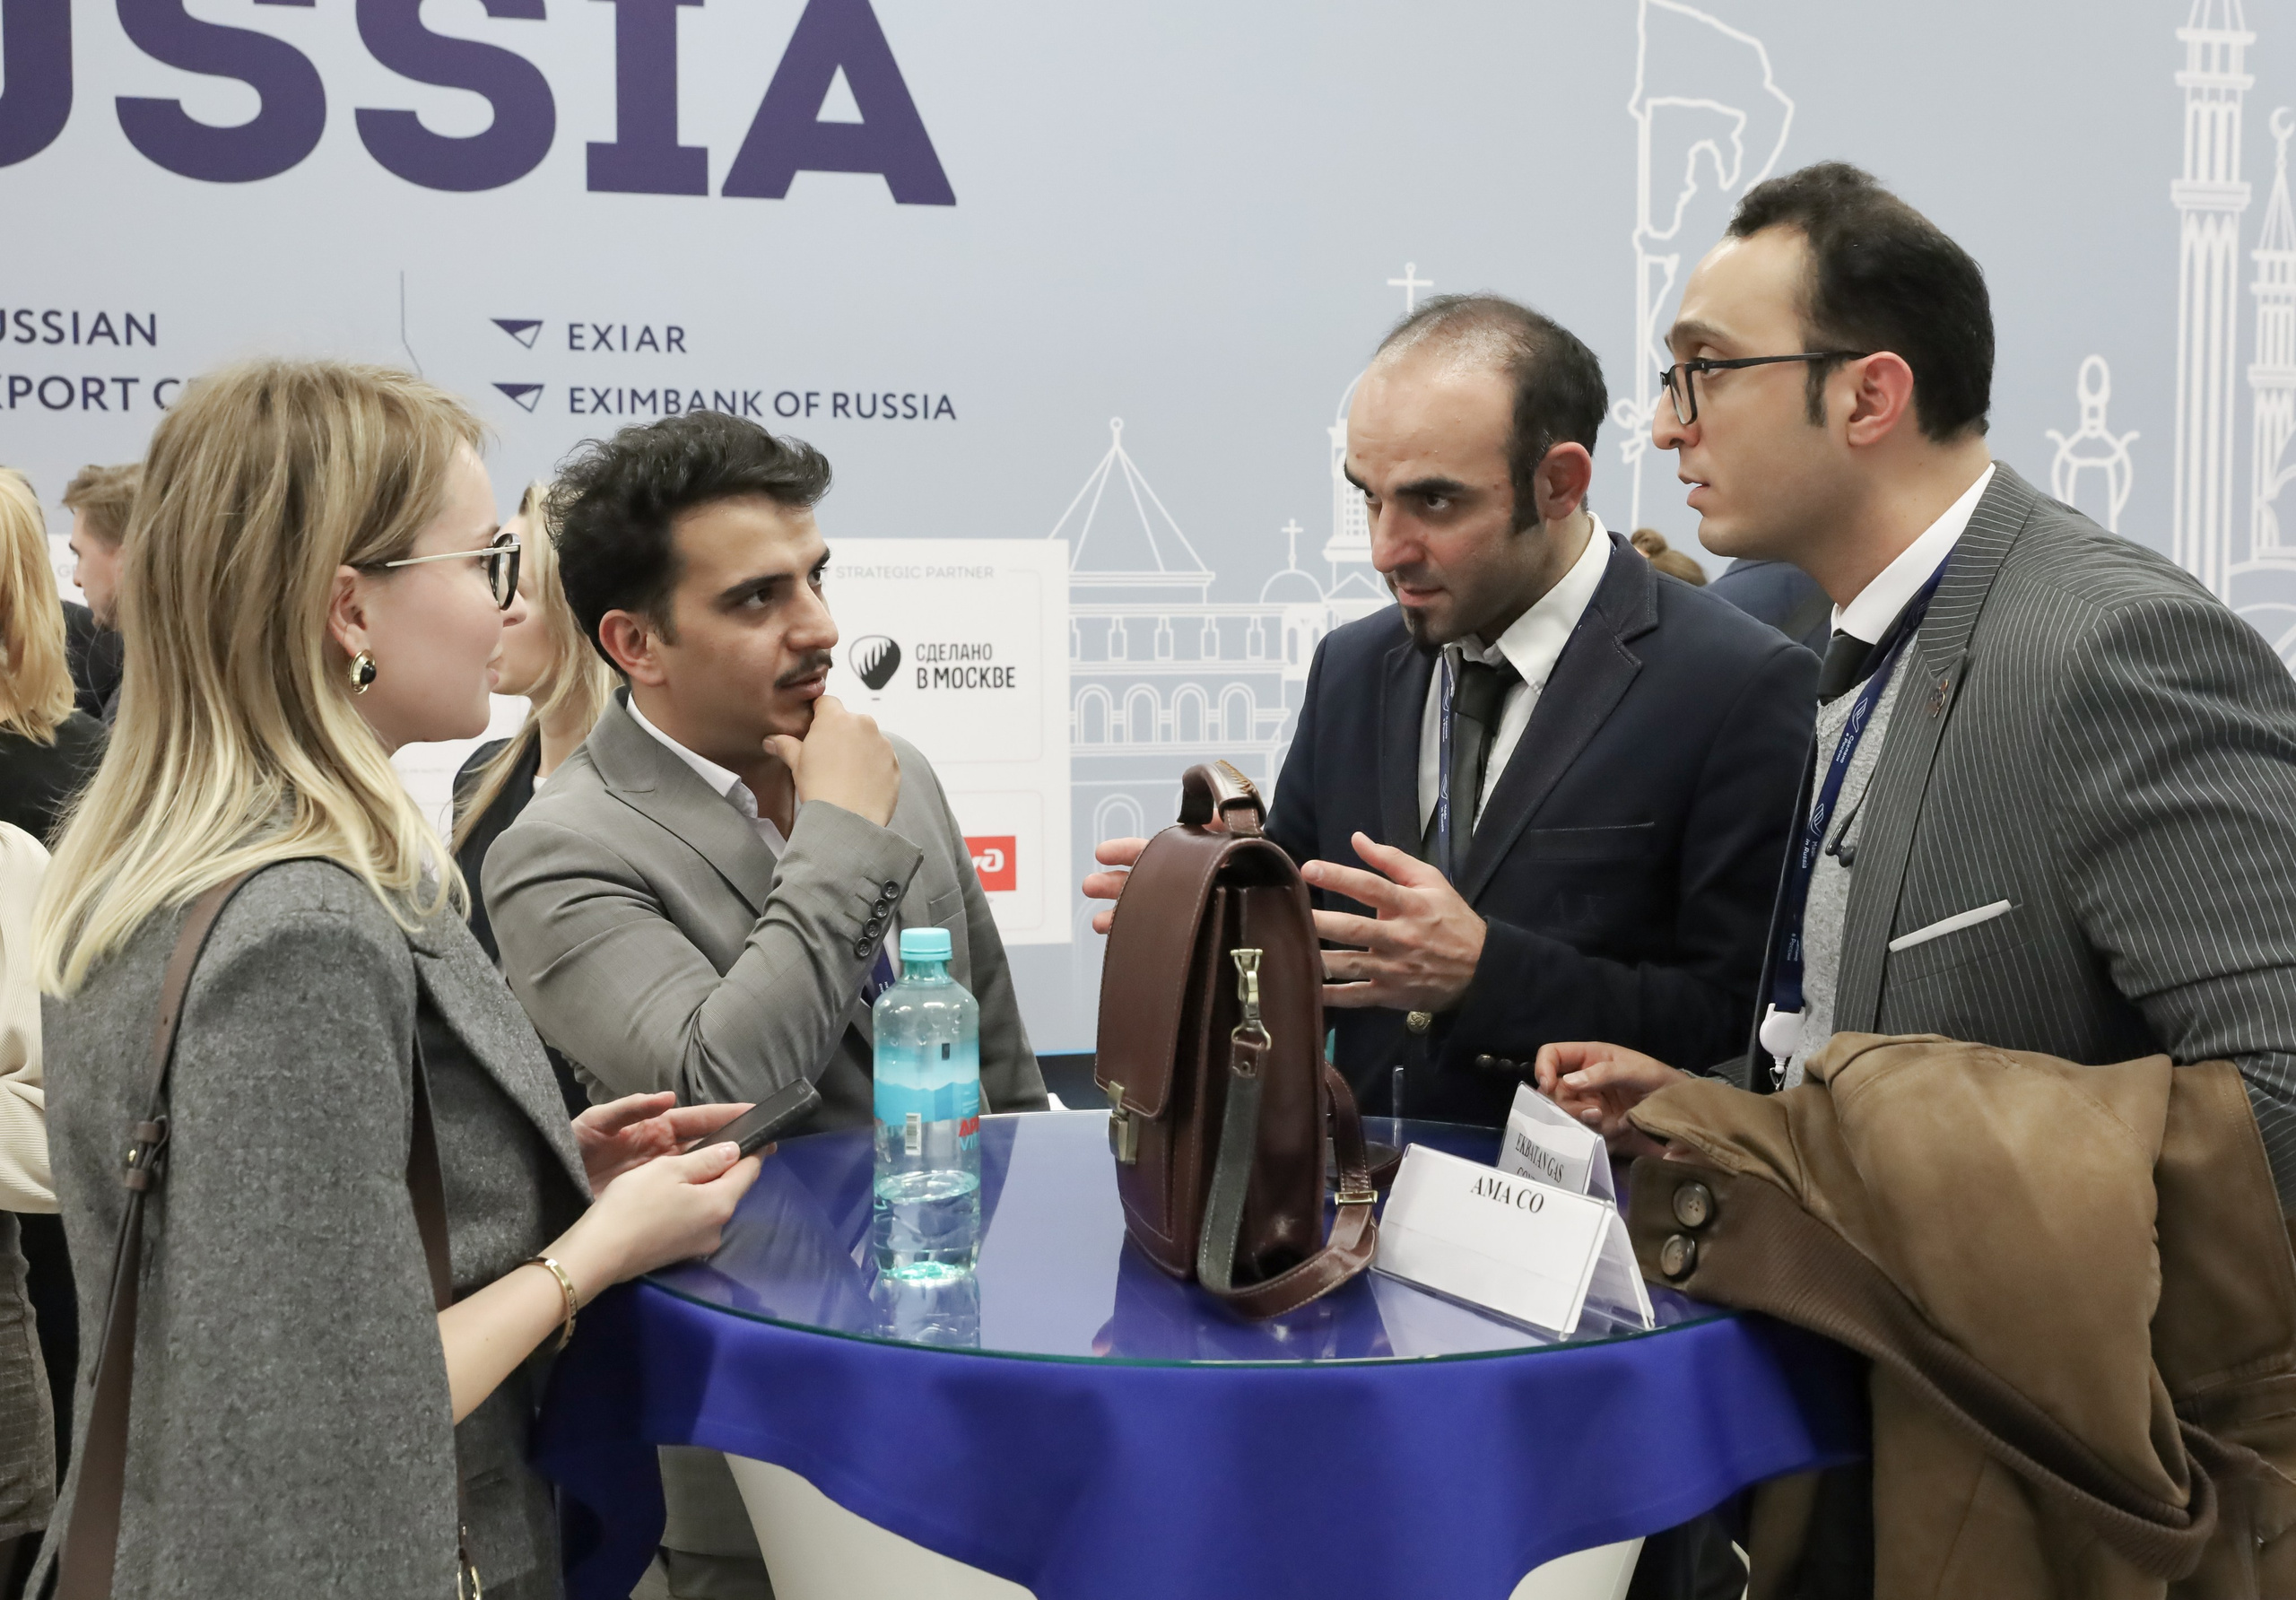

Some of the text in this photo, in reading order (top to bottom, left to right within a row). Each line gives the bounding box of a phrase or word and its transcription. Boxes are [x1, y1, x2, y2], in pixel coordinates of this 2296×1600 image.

[0, 309, 157, 347] SSIAN
[569, 323, 687, 352] EXIAR
[0, 375, 140, 412] PORT
[570, 387, 957, 421] EXIMBANK OF RUSSIA
[836, 566, 995, 579] STRATEGIC PARTNER
[916, 643, 993, 664] СДЕЛАНО
[918, 666, 1016, 690] В МОСКВЕ
[1470, 1176, 1544, 1213] AMA CO
